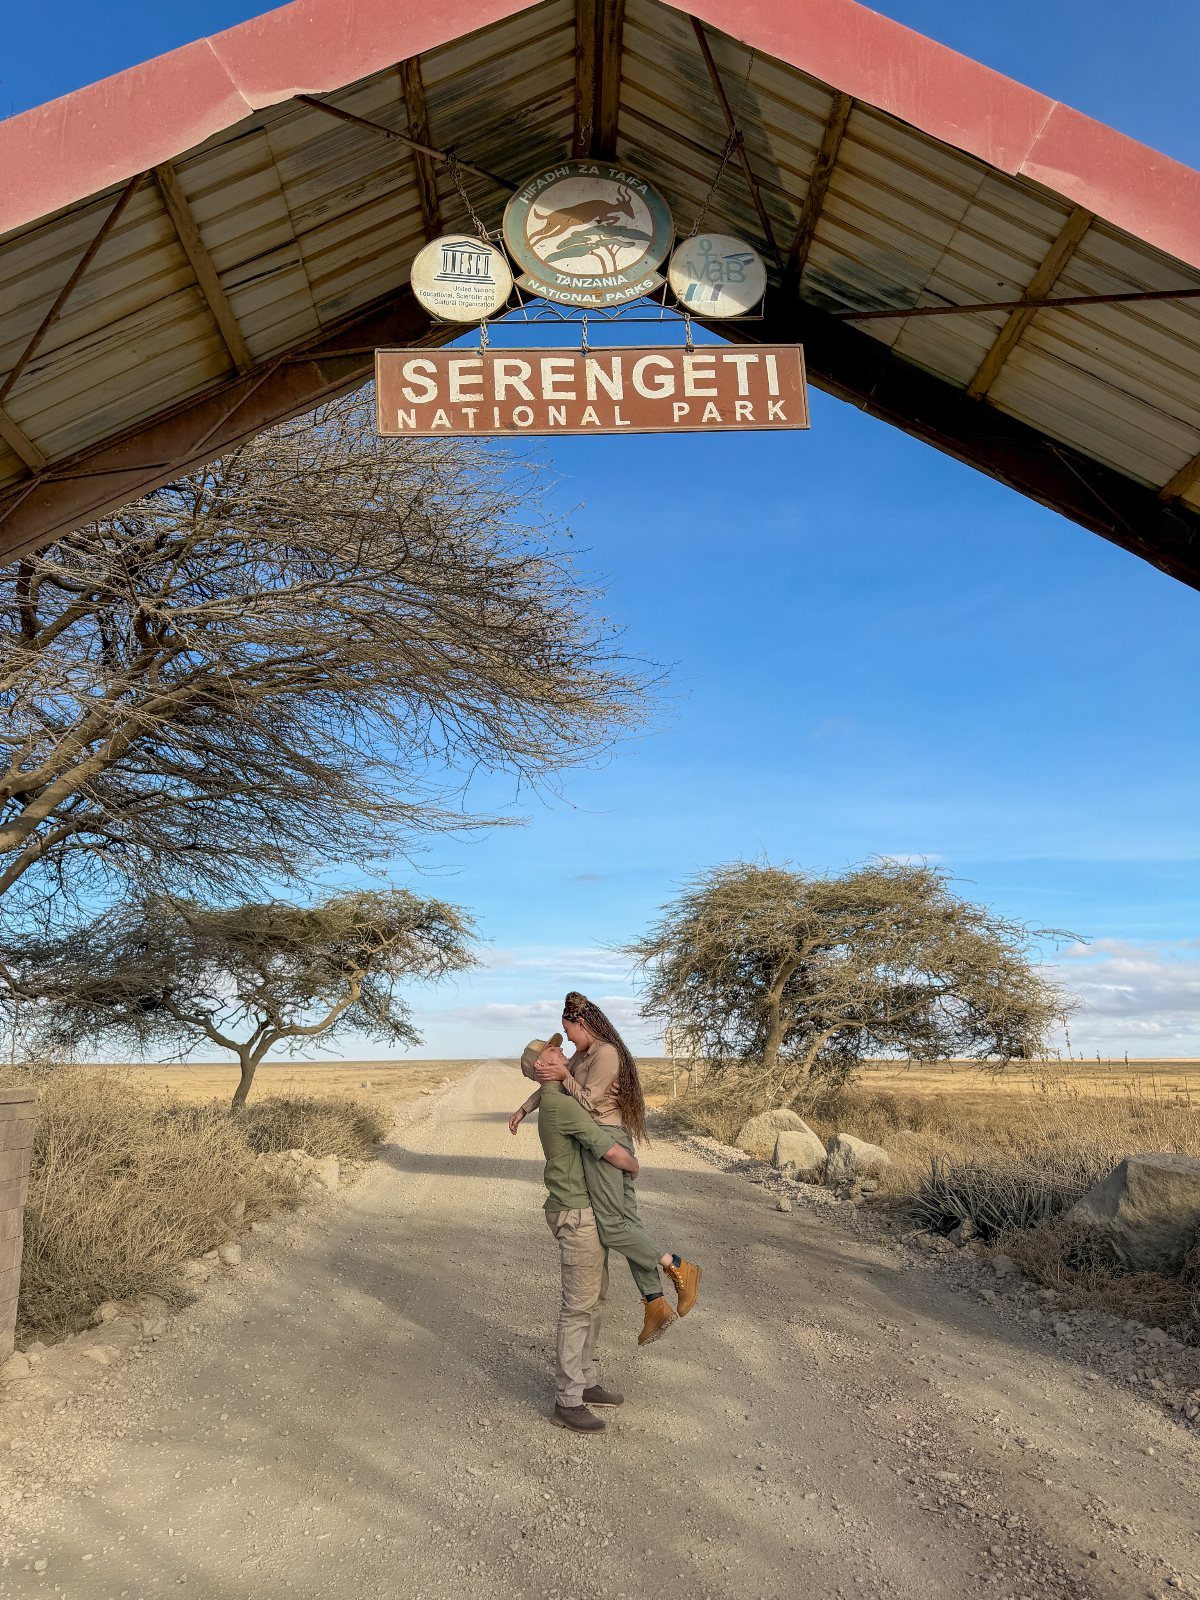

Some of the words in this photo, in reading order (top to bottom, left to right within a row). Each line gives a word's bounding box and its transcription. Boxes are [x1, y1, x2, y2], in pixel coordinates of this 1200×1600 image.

[519, 166, 570, 204] HIFADHI
[578, 164, 600, 175] ZA
[608, 168, 649, 196] TAIFA
[442, 251, 490, 276] UNESCO
[473, 286, 495, 294] Nations
[527, 279, 601, 303] NATIONAL
[605, 279, 654, 301] PARKS
[556, 273, 629, 288] TANZANIA
[419, 289, 455, 299] Educational,
[456, 292, 483, 300] Scientific
[434, 298, 457, 306] Cultural
[402, 354, 780, 404] SERENGETI
[397, 405, 631, 429] NATIONAL
[672, 399, 788, 423] PARK
